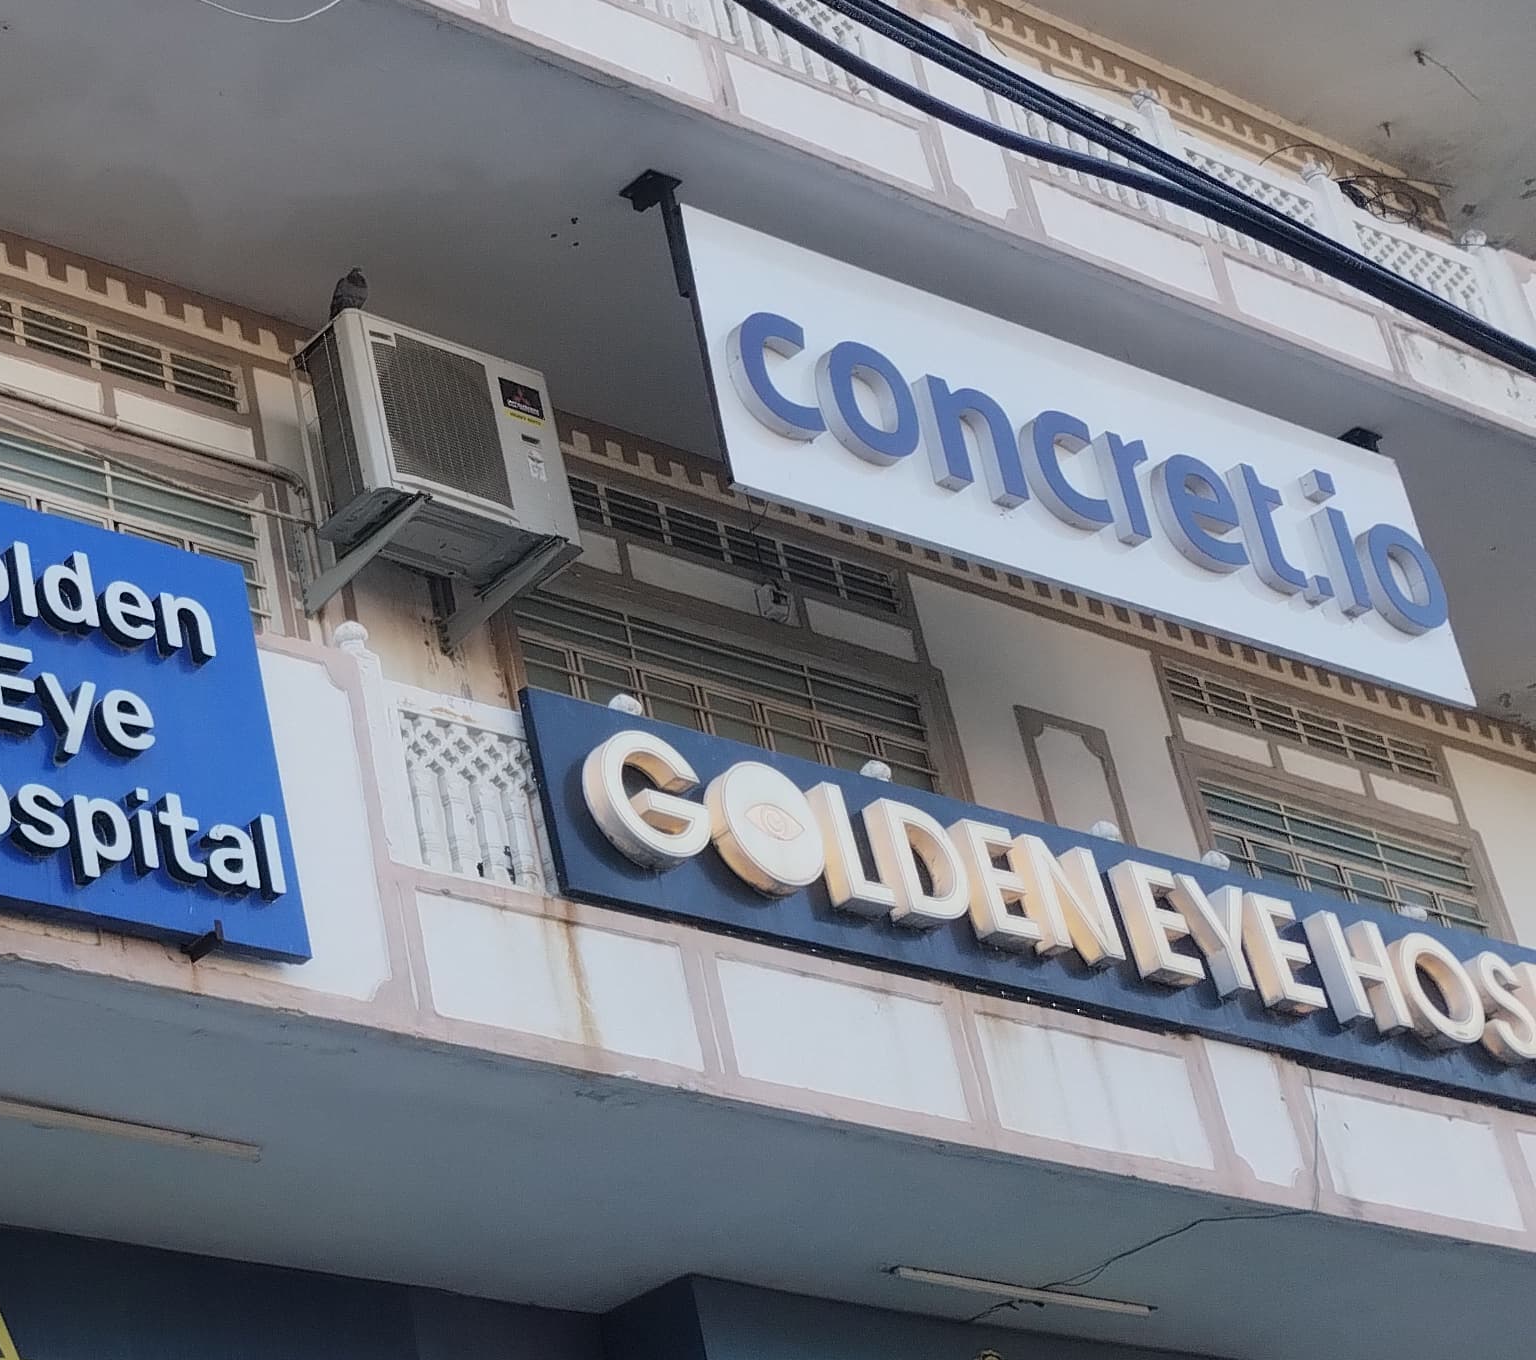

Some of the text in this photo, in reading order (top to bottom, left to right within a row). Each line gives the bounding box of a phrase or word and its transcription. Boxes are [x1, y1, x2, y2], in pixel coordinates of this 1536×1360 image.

[729, 311, 1448, 636] concret.io
[582, 730, 1536, 1060] GOLDEN EYE HOS
